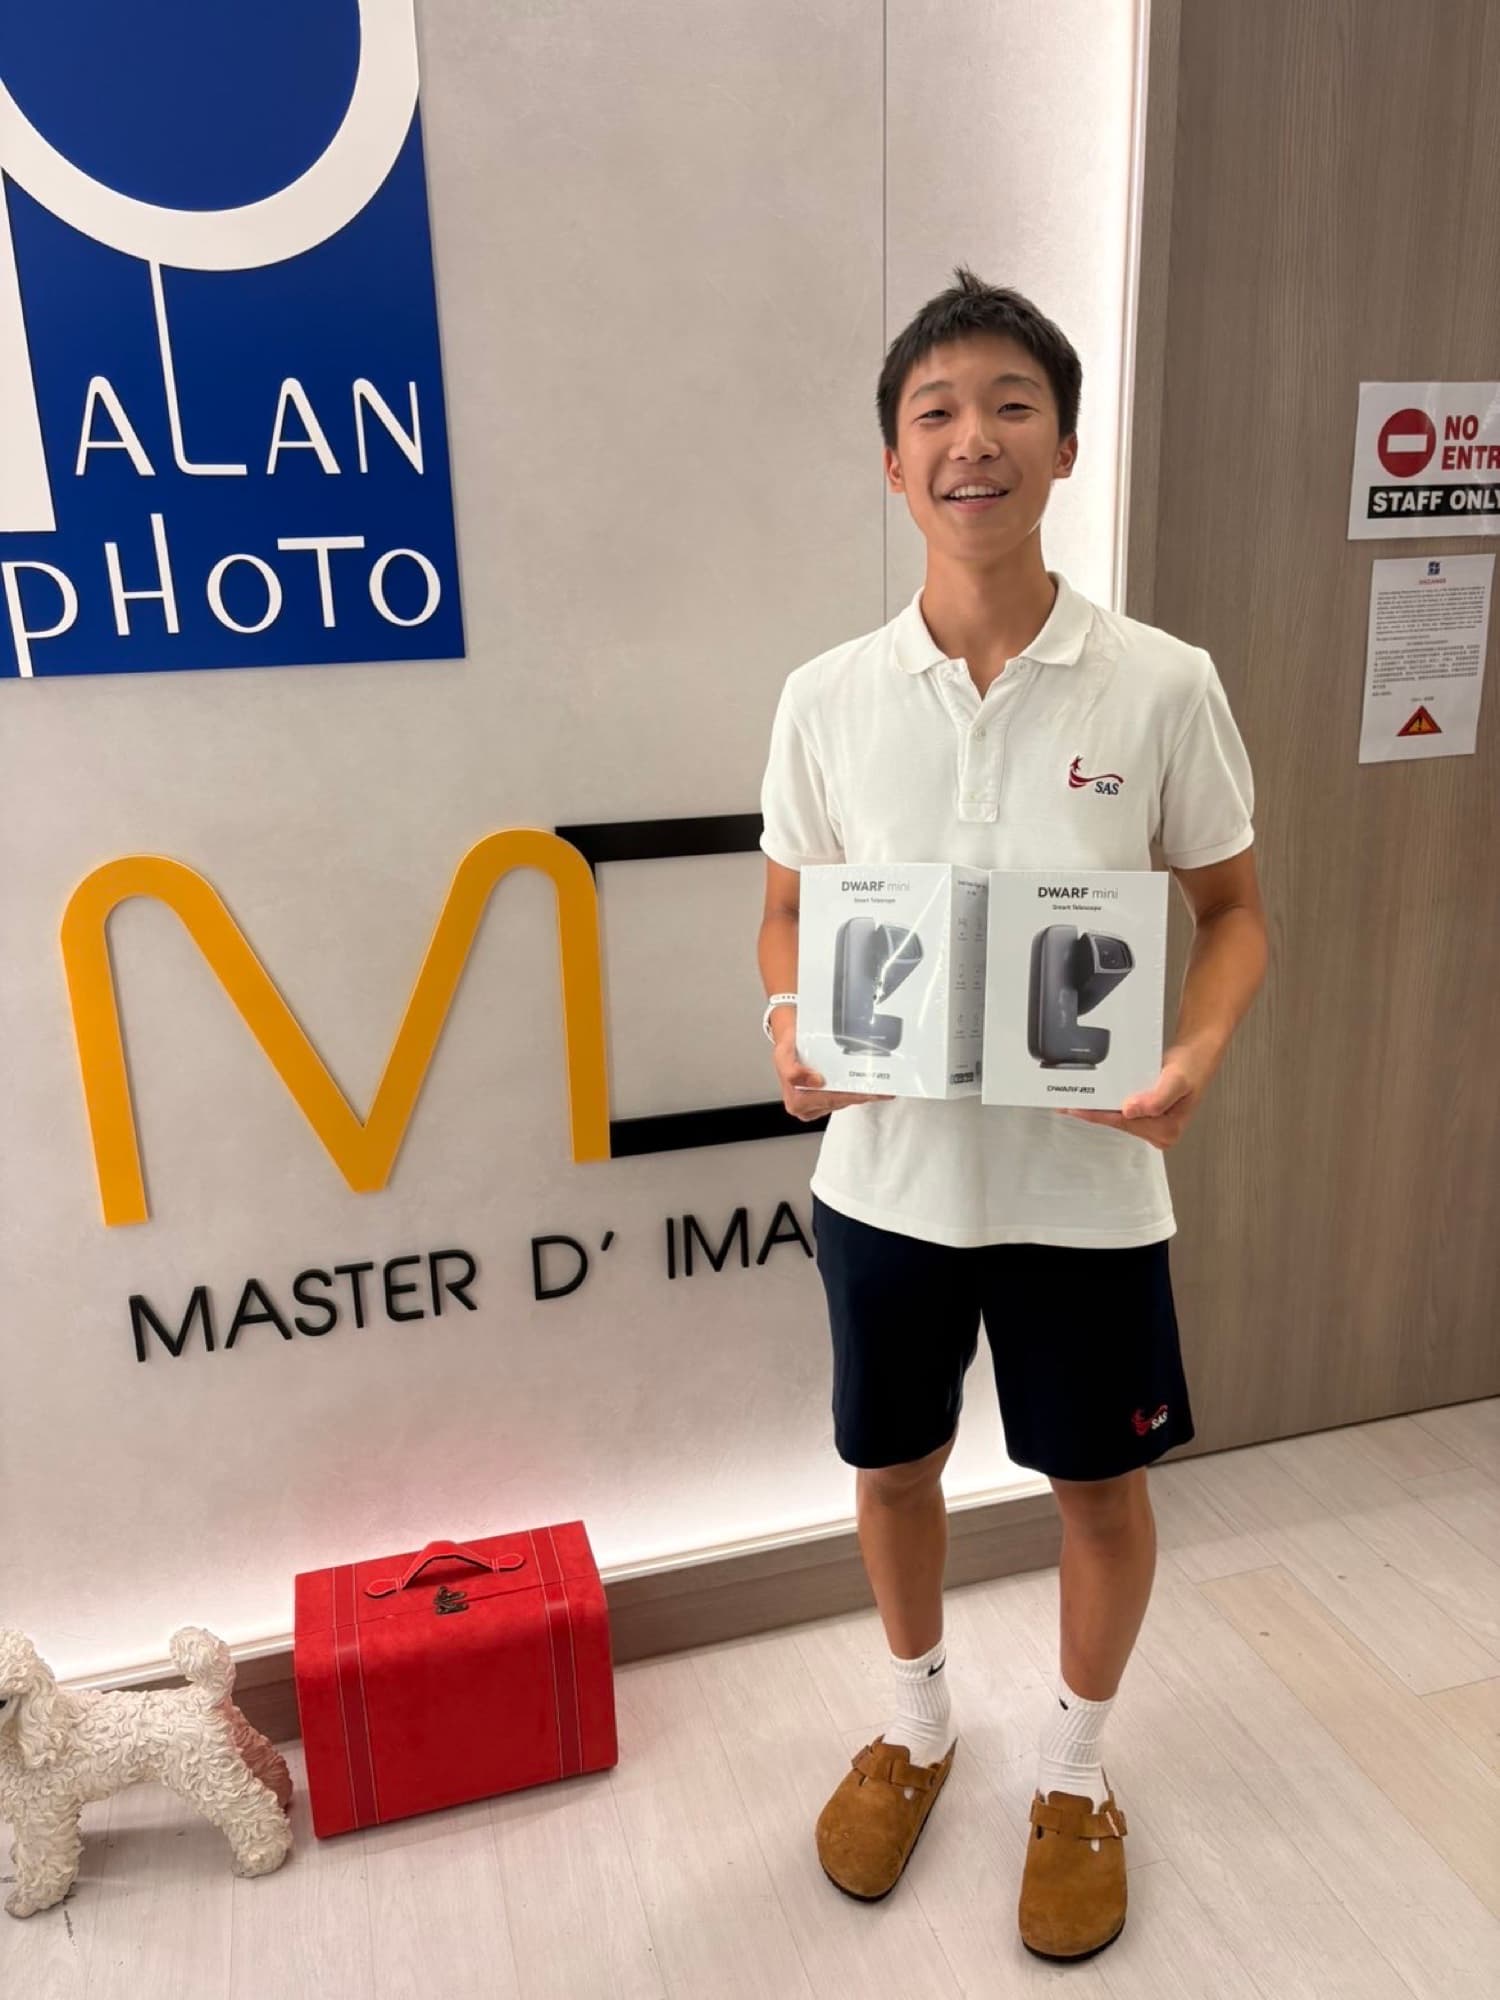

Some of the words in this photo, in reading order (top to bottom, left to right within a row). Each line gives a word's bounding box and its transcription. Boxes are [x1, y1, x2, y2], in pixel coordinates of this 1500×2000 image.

[75, 260, 424, 476] ALAN
[1444, 415, 1479, 441] NO
[1373, 491, 1444, 512] STAFF
[1095, 781, 1120, 795] SAS
[841, 880, 886, 892] DWARF
[887, 880, 911, 892] mini
[1037, 886, 1089, 899] DWARF
[1092, 887, 1119, 899] mini
[128, 1249, 479, 1363] MASTER
[1151, 1411, 1168, 1430] SAS
